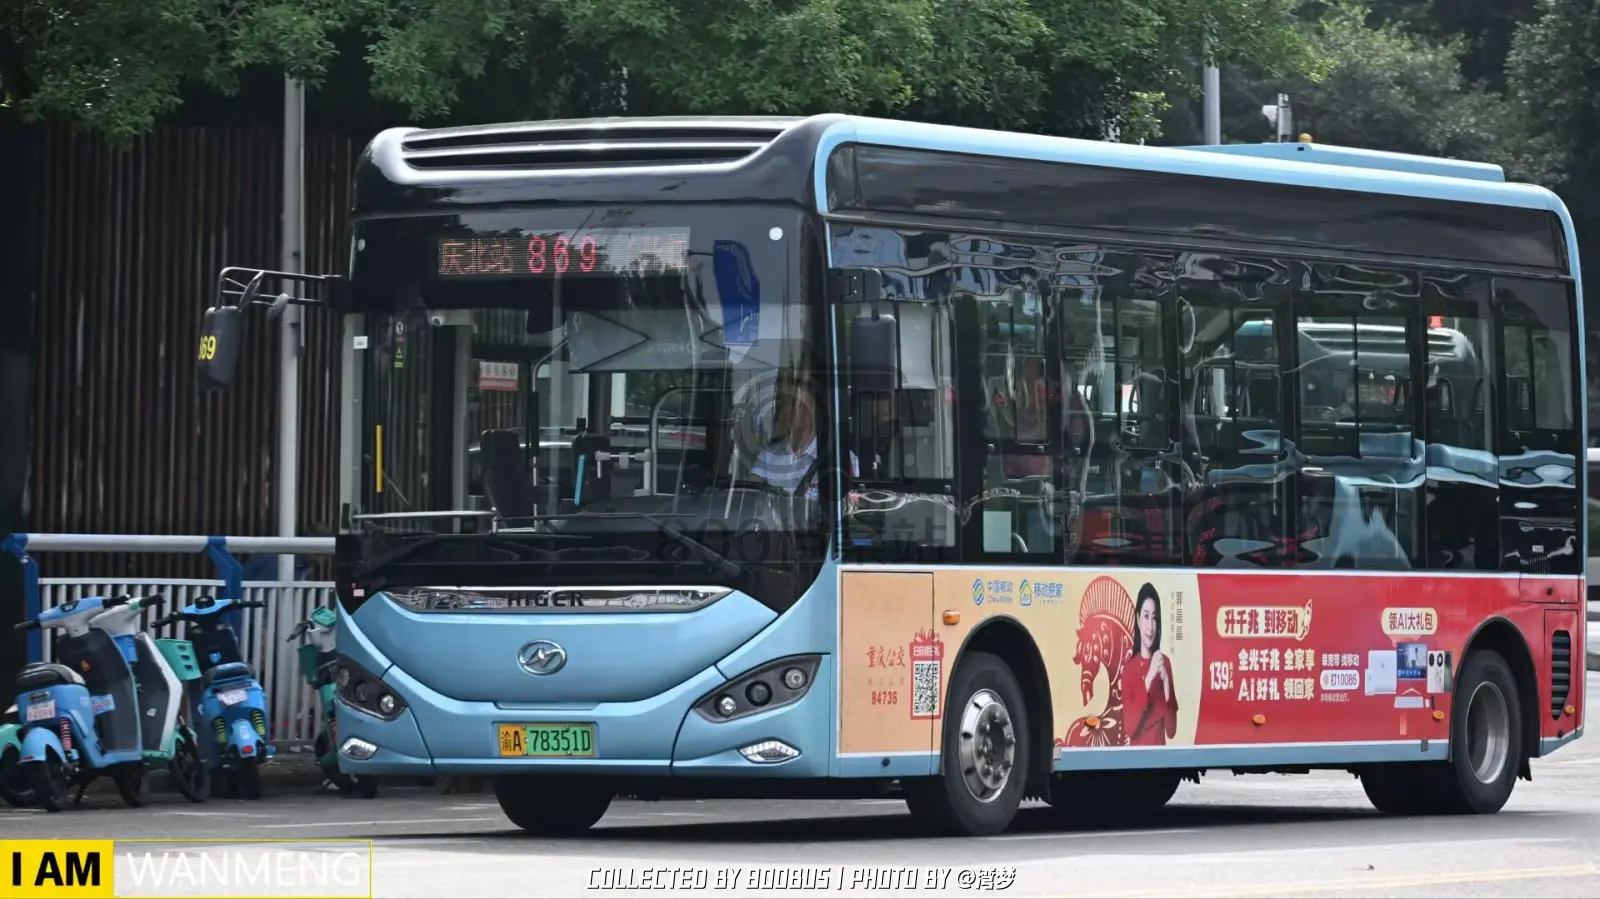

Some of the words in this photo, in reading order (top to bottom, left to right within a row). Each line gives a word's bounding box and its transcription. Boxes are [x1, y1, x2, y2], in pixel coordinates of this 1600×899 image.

[528, 234, 596, 274] 869
[198, 335, 216, 360] 69
[987, 579, 1013, 593] 中国移动
[507, 591, 584, 607] HIGER
[1224, 608, 1259, 635] 升千兆
[1264, 608, 1299, 635] 到移动
[1389, 611, 1433, 631] 领AI大礼包
[866, 646, 906, 669] 重庆公交
[1238, 648, 1280, 671] 全光千兆
[1284, 648, 1315, 671] 全家享
[1209, 661, 1229, 690] 139
[871, 690, 897, 705] 84736
[1284, 677, 1315, 701] 领回家
[501, 730, 522, 752] 渝A
[529, 729, 591, 752] 78351D
